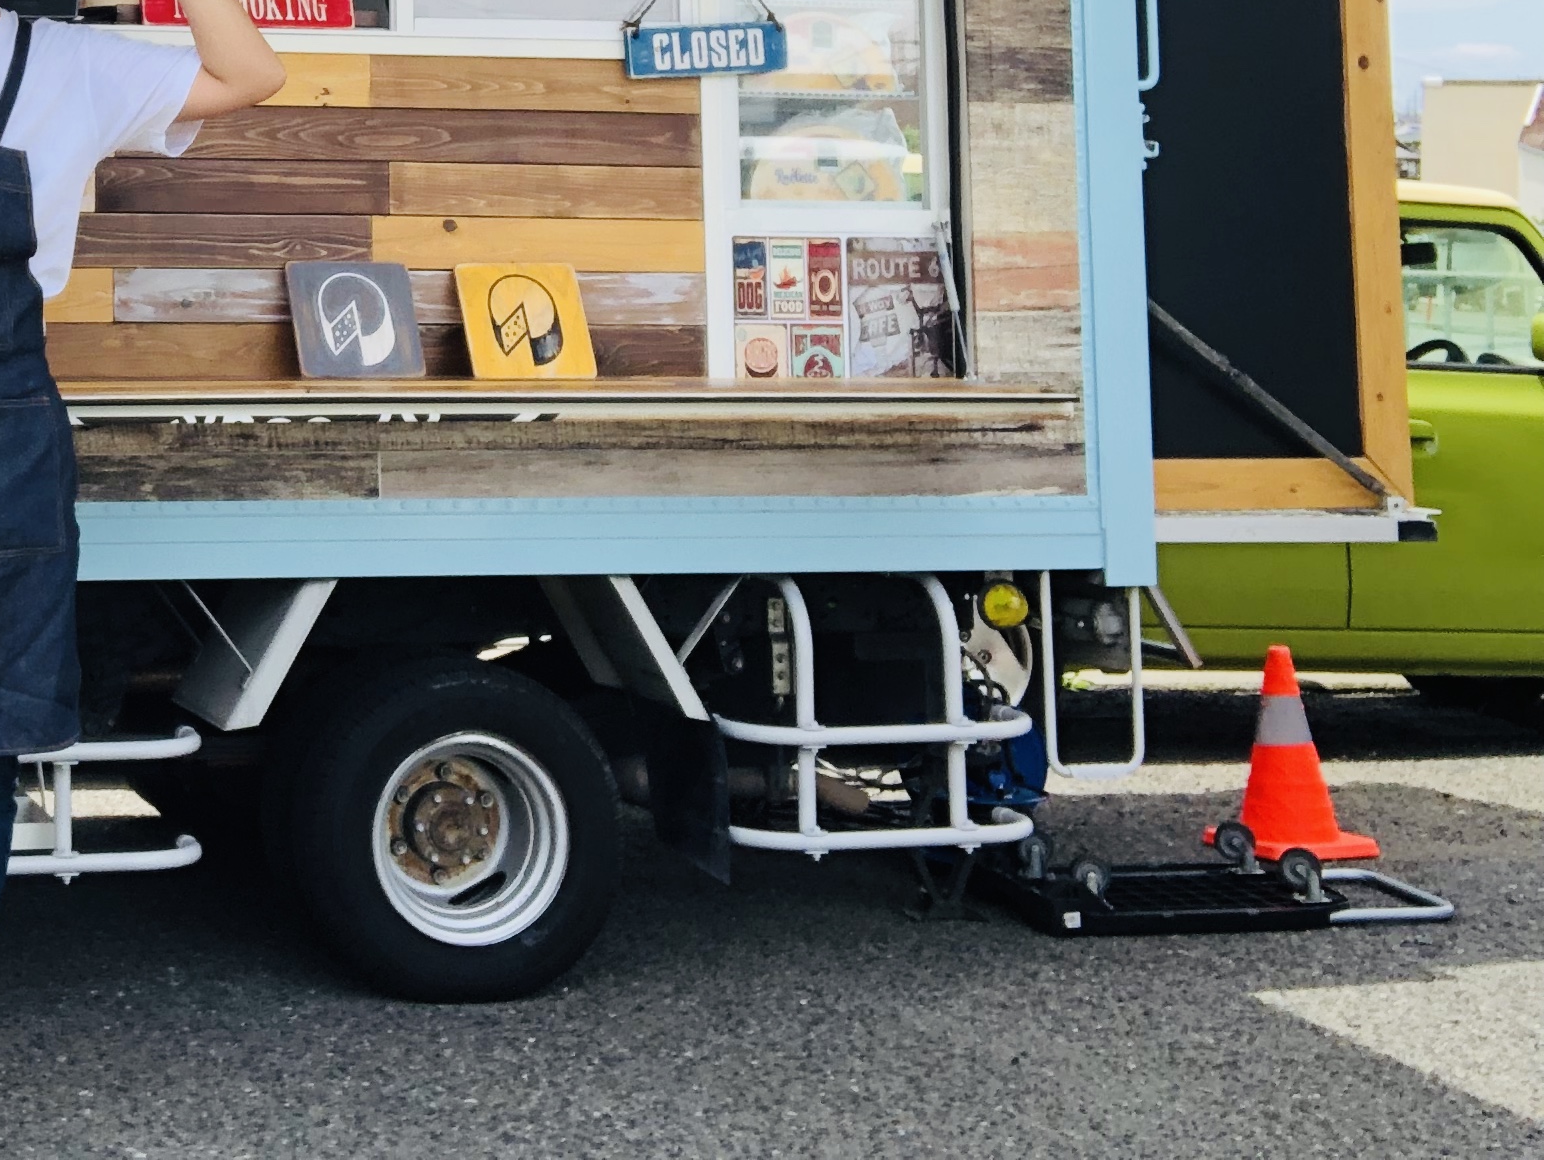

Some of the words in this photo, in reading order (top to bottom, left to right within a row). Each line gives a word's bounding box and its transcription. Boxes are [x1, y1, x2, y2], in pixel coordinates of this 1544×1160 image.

[654, 28, 766, 71] CLOSED
[852, 256, 922, 281] ROUTE
[736, 280, 764, 312] DOG
[774, 300, 803, 313] FOOD
